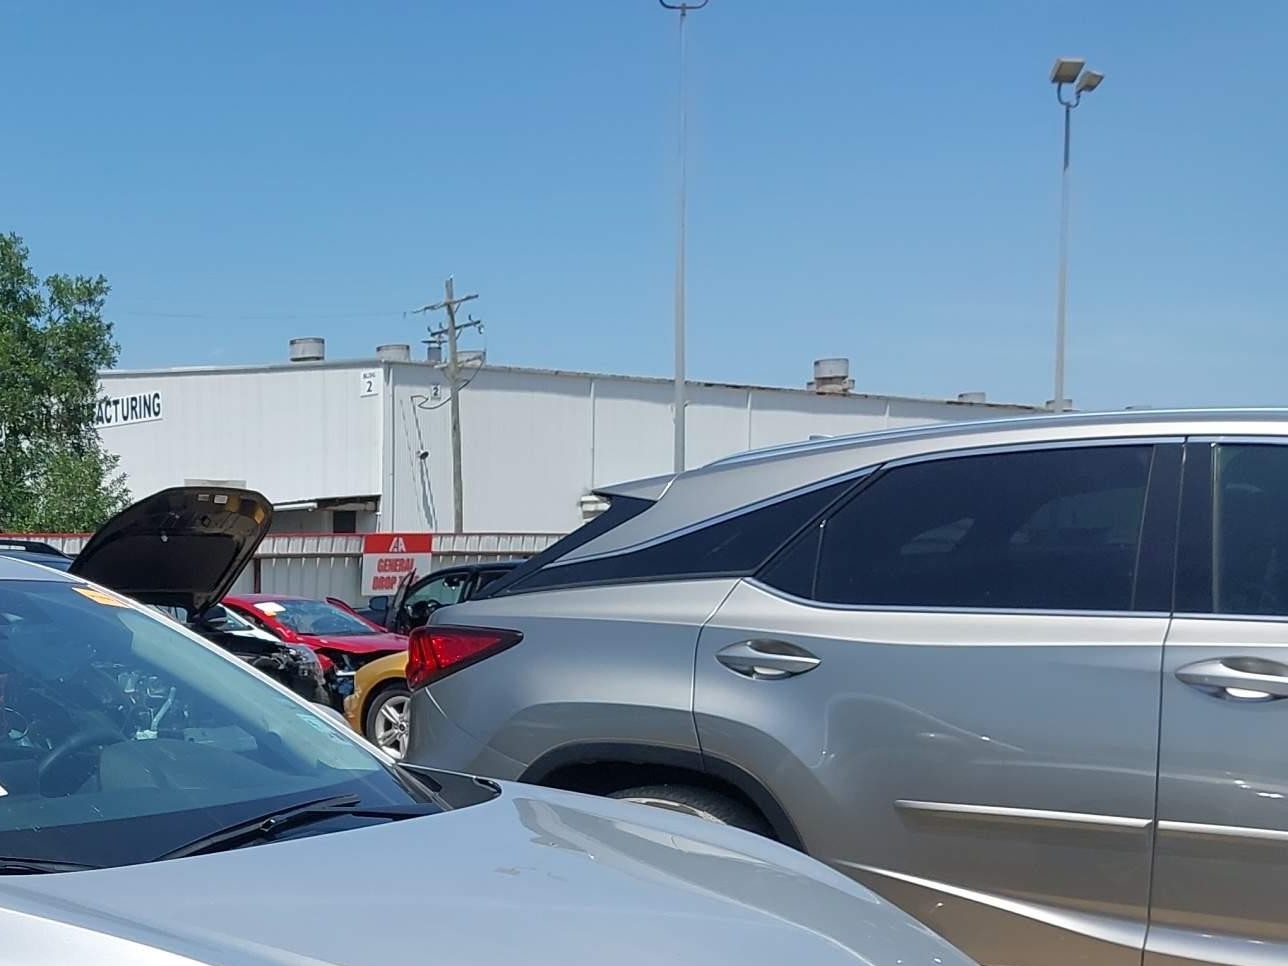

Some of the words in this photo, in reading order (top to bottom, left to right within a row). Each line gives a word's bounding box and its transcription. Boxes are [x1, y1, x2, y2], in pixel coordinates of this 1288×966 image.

[366, 380, 373, 393] 2
[432, 386, 440, 396] 2
[377, 558, 414, 573] GENERAL
[372, 576, 397, 591] DROP
